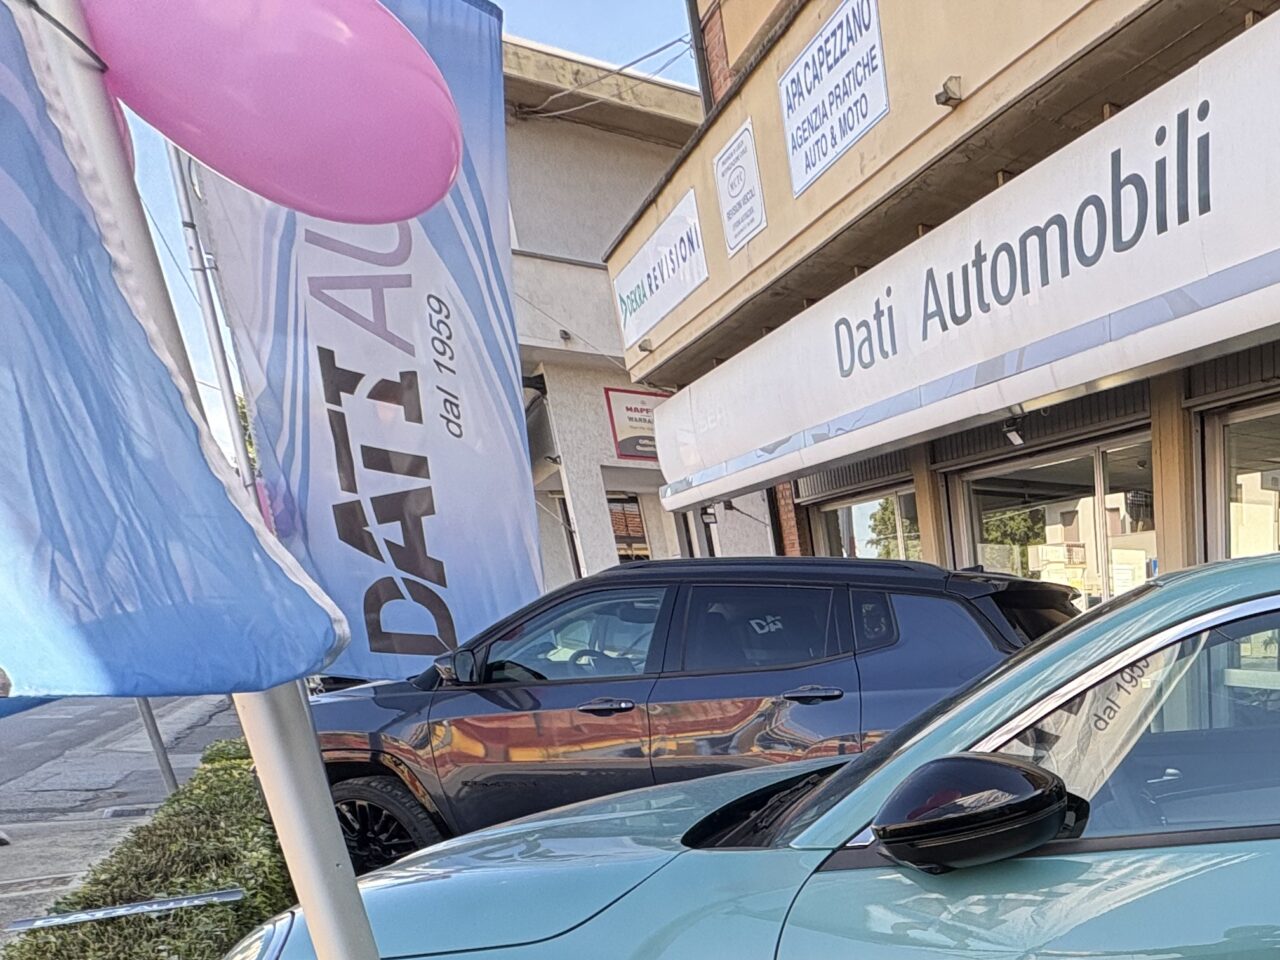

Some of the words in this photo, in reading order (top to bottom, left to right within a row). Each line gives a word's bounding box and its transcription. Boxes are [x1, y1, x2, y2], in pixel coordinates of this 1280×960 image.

[785, 71, 805, 119] APA
[803, 0, 872, 97] CAPEZZANO
[791, 99, 829, 155] AGENZIA
[828, 44, 878, 117] PRATICHE
[804, 134, 828, 175] AUTO
[830, 125, 838, 149] &
[838, 93, 869, 142] MOTO
[626, 279, 648, 317] DEKRA
[646, 222, 701, 297] REVISIONI
[834, 285, 897, 379] Dati
[920, 99, 1212, 343] Automobili
[305, 221, 415, 358] AU
[427, 293, 456, 376] 1959
[436, 384, 464, 439] dal
[625, 405, 653, 415] MAPF
[1092, 698, 1122, 732] dal
